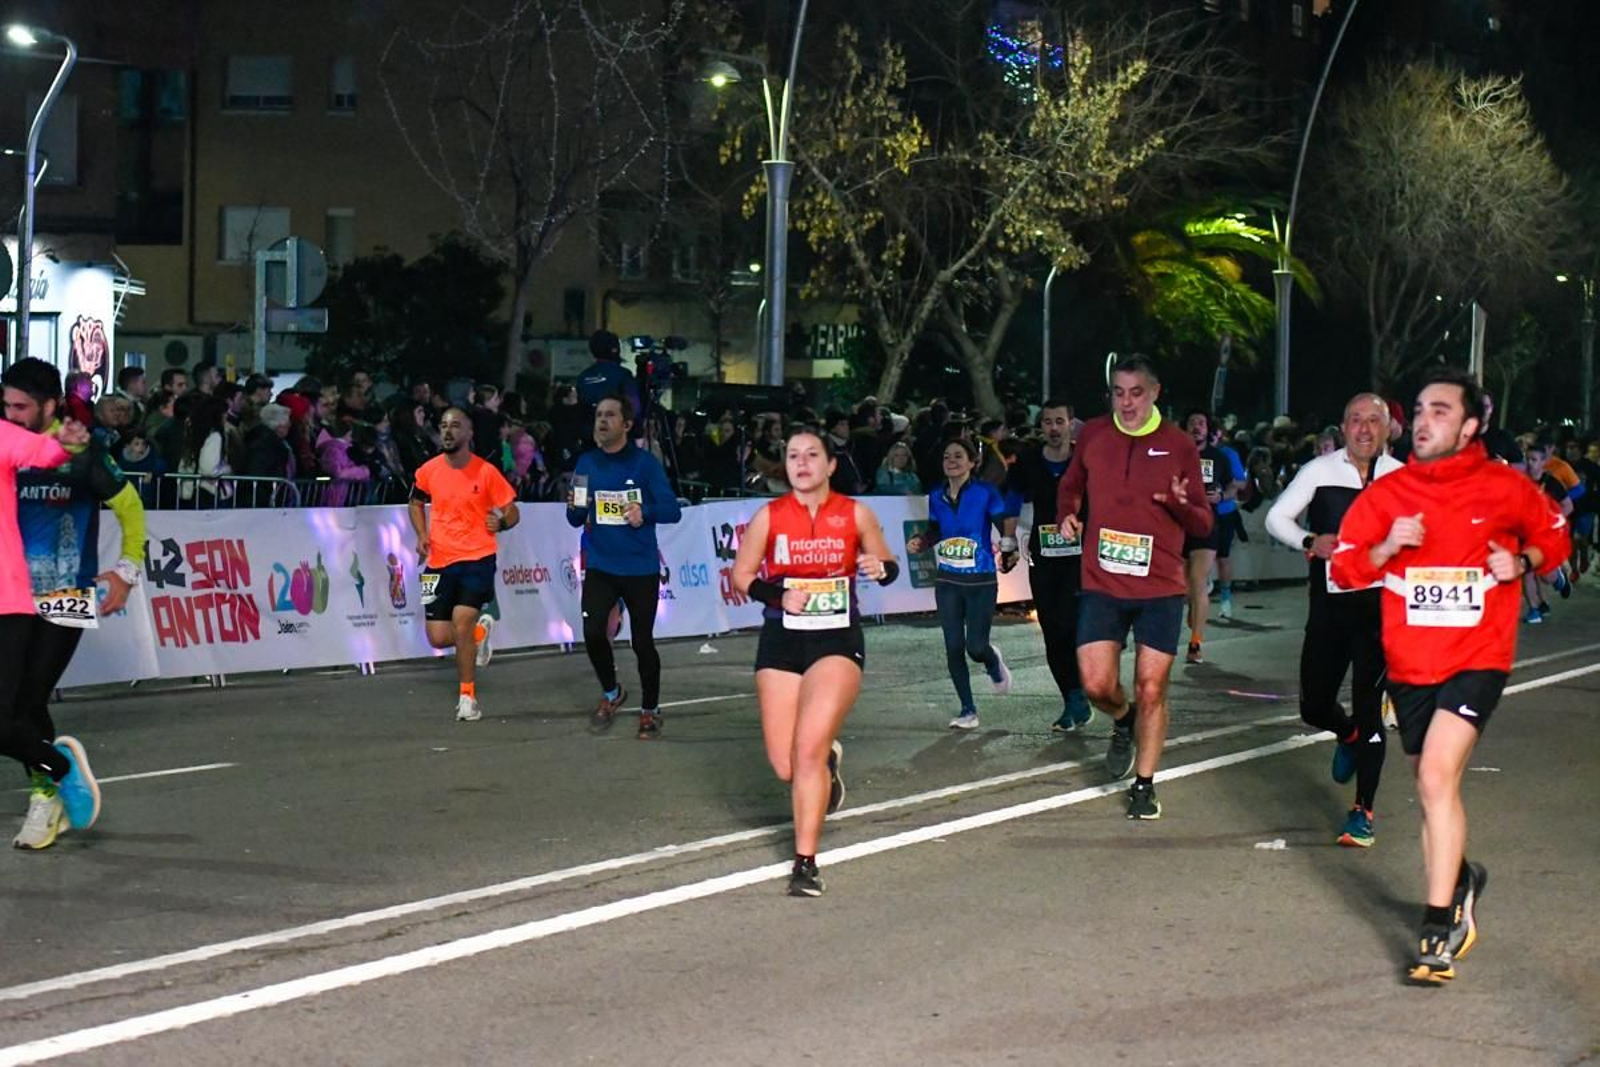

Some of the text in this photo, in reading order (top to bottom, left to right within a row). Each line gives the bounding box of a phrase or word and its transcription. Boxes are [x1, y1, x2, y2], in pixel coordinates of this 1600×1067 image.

[20, 482, 71, 501] ANTÓN
[1101, 541, 1147, 562] 2735
[185, 538, 252, 592] SAN
[502, 562, 552, 586] calderón
[680, 558, 710, 588] alsa
[1414, 585, 1473, 604] 8941
[39, 598, 90, 615] 9422
